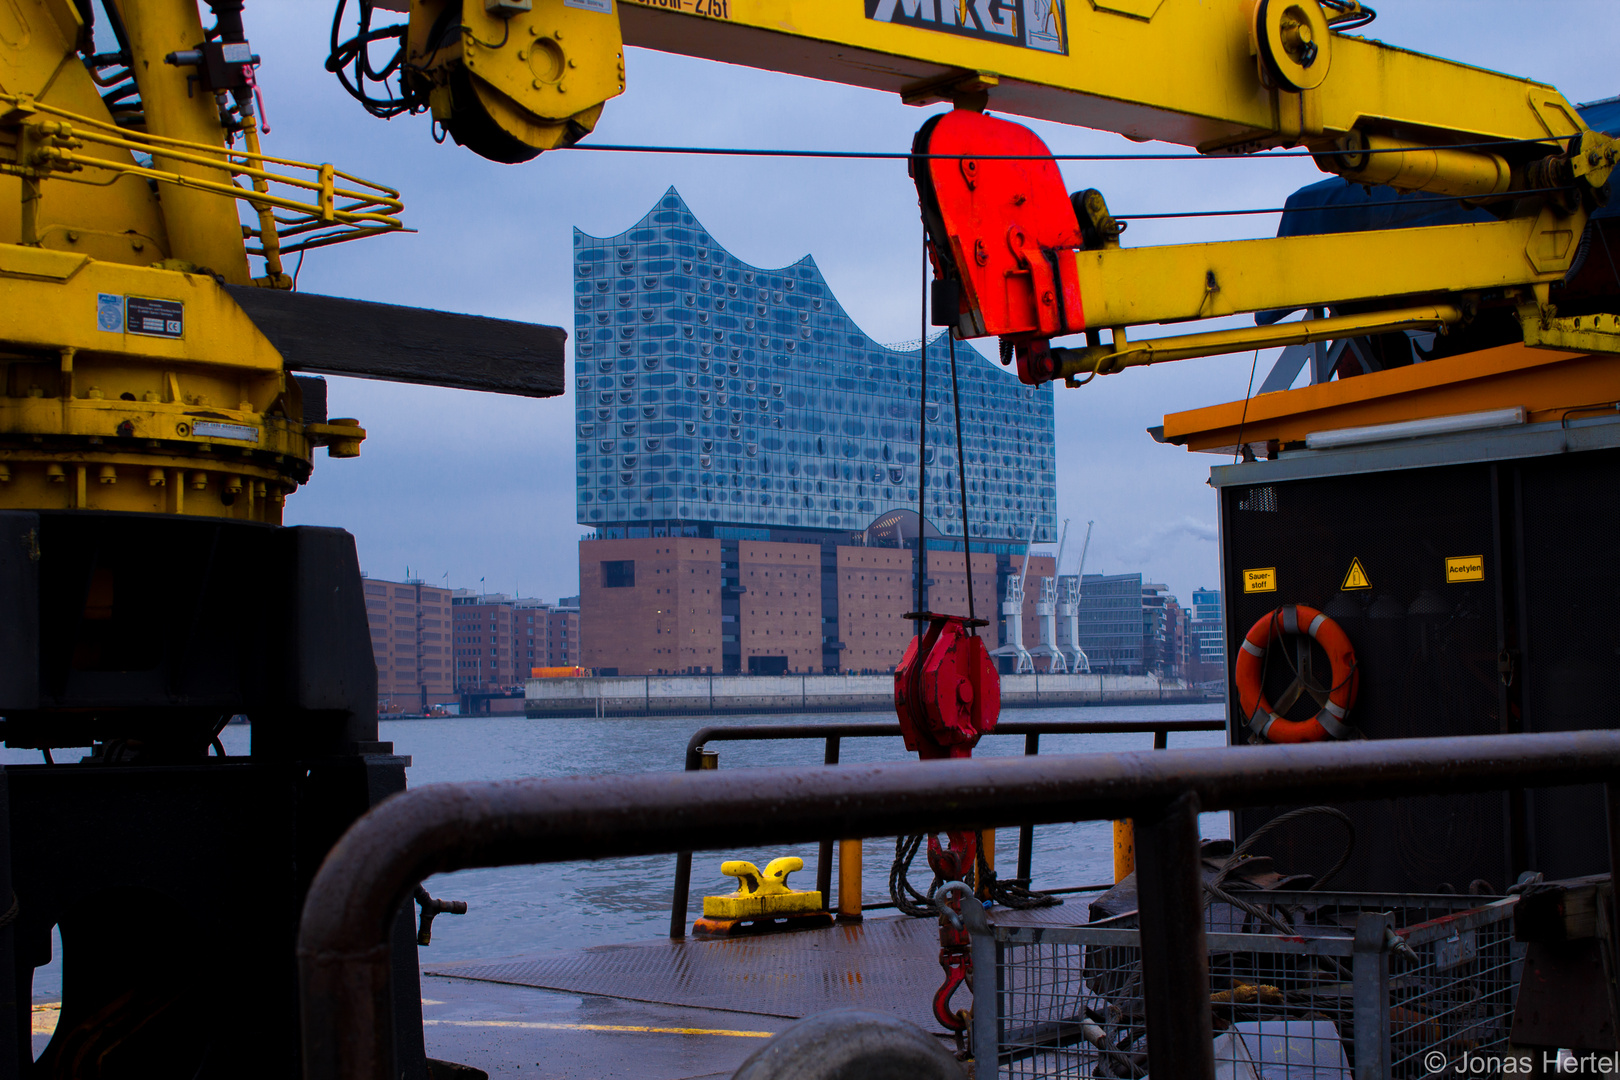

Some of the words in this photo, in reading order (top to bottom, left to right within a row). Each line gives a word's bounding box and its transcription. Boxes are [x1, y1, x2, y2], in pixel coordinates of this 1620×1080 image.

[168, 322, 178, 331] CE
[1449, 564, 1482, 573] Acetylen
[1251, 581, 1267, 589] stoff
